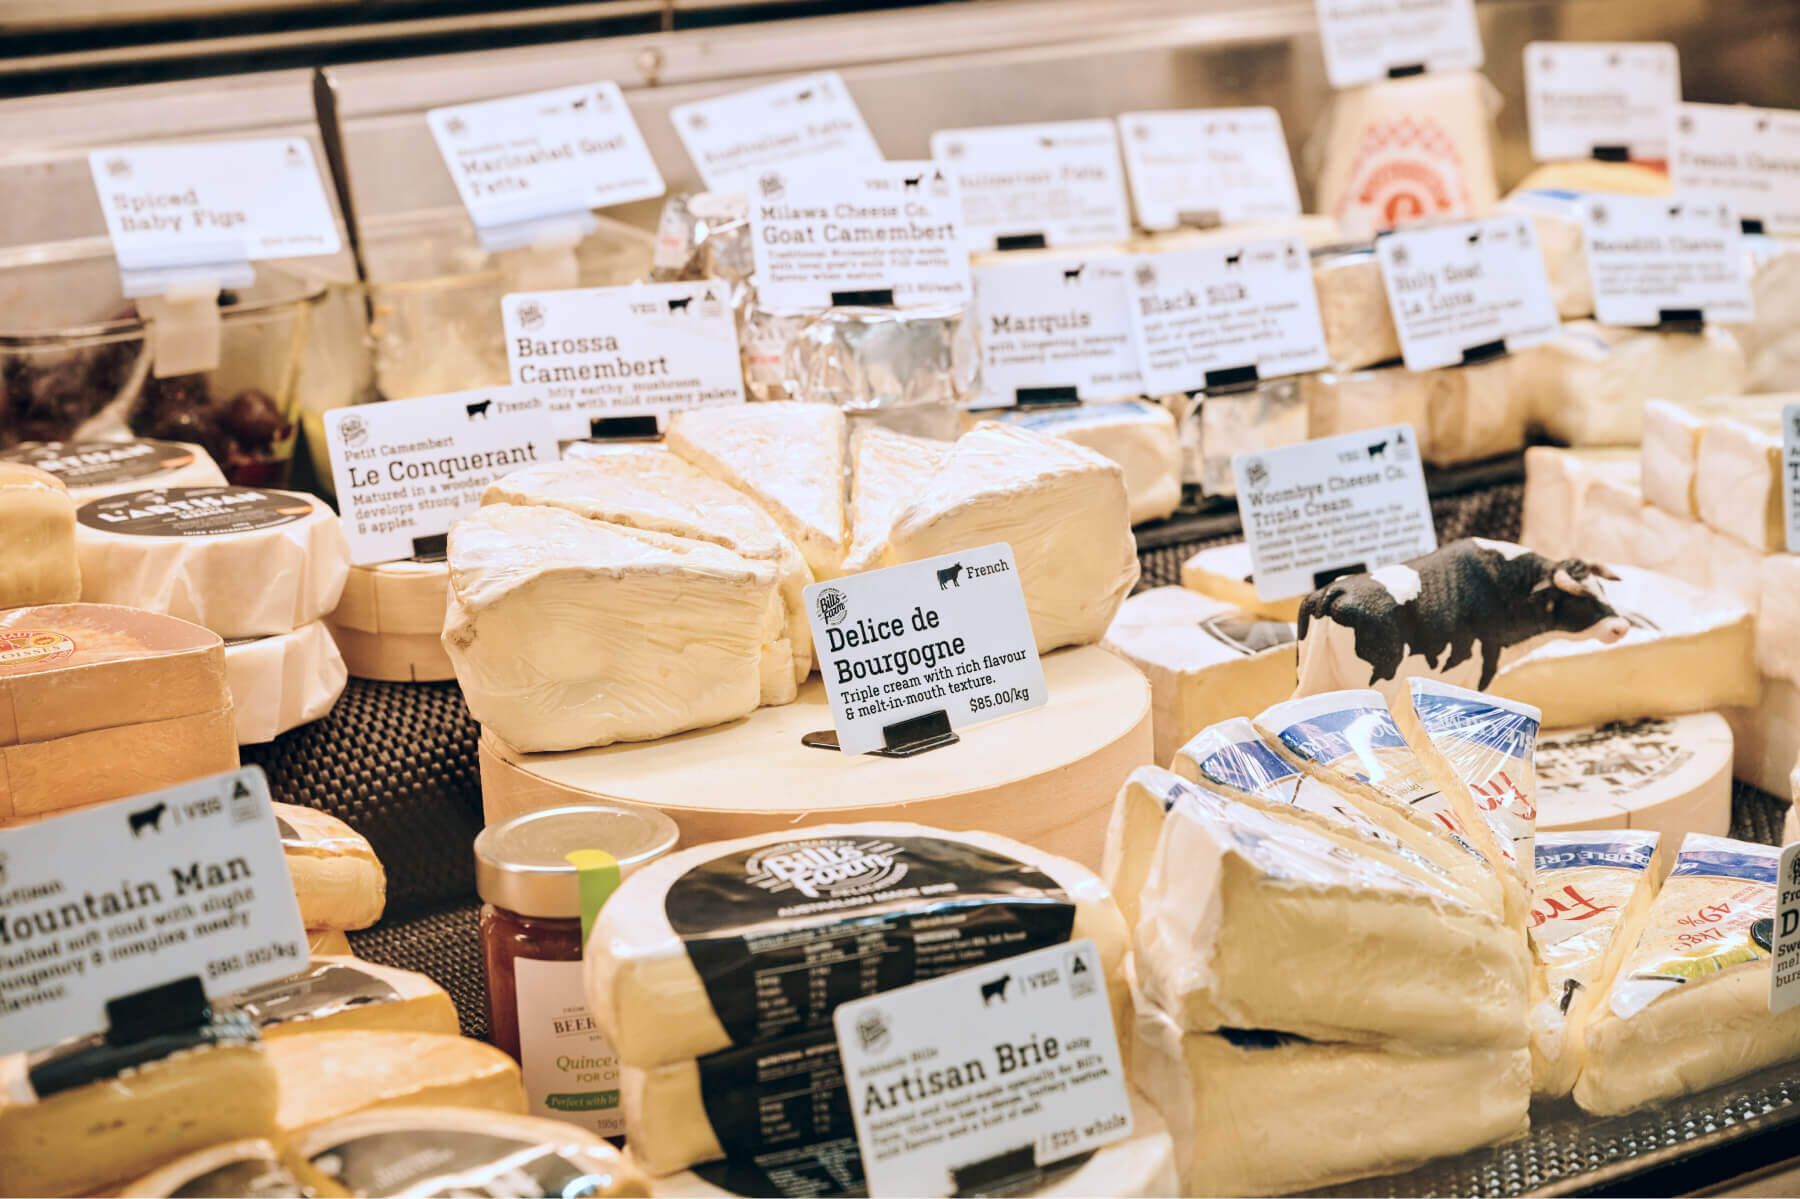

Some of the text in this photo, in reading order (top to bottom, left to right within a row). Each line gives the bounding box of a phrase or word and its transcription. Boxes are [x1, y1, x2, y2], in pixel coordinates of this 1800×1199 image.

[461, 144, 573, 175] Marinated
[579, 133, 625, 154] Goat
[113, 187, 199, 213] Spiced
[761, 203, 929, 221] Milawa Cheese Co.
[120, 209, 248, 233] Baby Figs
[762, 222, 957, 245] Goat Camembert
[631, 303, 657, 314] VEG
[990, 311, 1091, 334] Marquis
[517, 335, 619, 358] Barossa
[519, 356, 669, 384] Camembert
[497, 398, 542, 414] French
[576, 399, 607, 410] with
[612, 394, 642, 406] mild
[646, 391, 693, 406] creamy
[344, 436, 455, 463] Petit Camembert
[349, 441, 538, 488] Le Conquerant
[353, 488, 407, 507] Matured
[412, 486, 426, 498] in
[429, 485, 437, 494] a
[440, 475, 490, 492] wooden
[1248, 482, 1324, 507] Woombye
[1327, 472, 1381, 492] Cheese
[355, 494, 460, 521] develops strong
[1252, 499, 1353, 528] Triple Cream
[371, 517, 417, 534] apples.
[966, 559, 1010, 579] French
[826, 607, 940, 652] Delice de
[834, 636, 966, 684] Bourgogne
[841, 649, 1027, 705] Triple cream with rich flavour
[845, 674, 996, 721] & melt-in-mouth texture.
[969, 687, 1030, 713] $85.00/kg
[184, 797, 222, 819] VEG
[170, 856, 251, 897] Man
[794, 853, 895, 898] Farm
[0, 881, 63, 907] rtisan
[1677, 901, 1731, 928] 49%
[1780, 908, 1800, 938] D
[0, 887, 255, 972] ashed soft rind with slight
[109, 928, 187, 962] complex
[1777, 955, 1800, 973] mel
[1028, 968, 1060, 990] VEG
[556, 1055, 613, 1072] Quince
[863, 1033, 1061, 1116] Artisan Brie
[576, 1073, 600, 1083] FOR
[551, 1094, 606, 1108] Perfect with
[1083, 1113, 1127, 1139] whole
